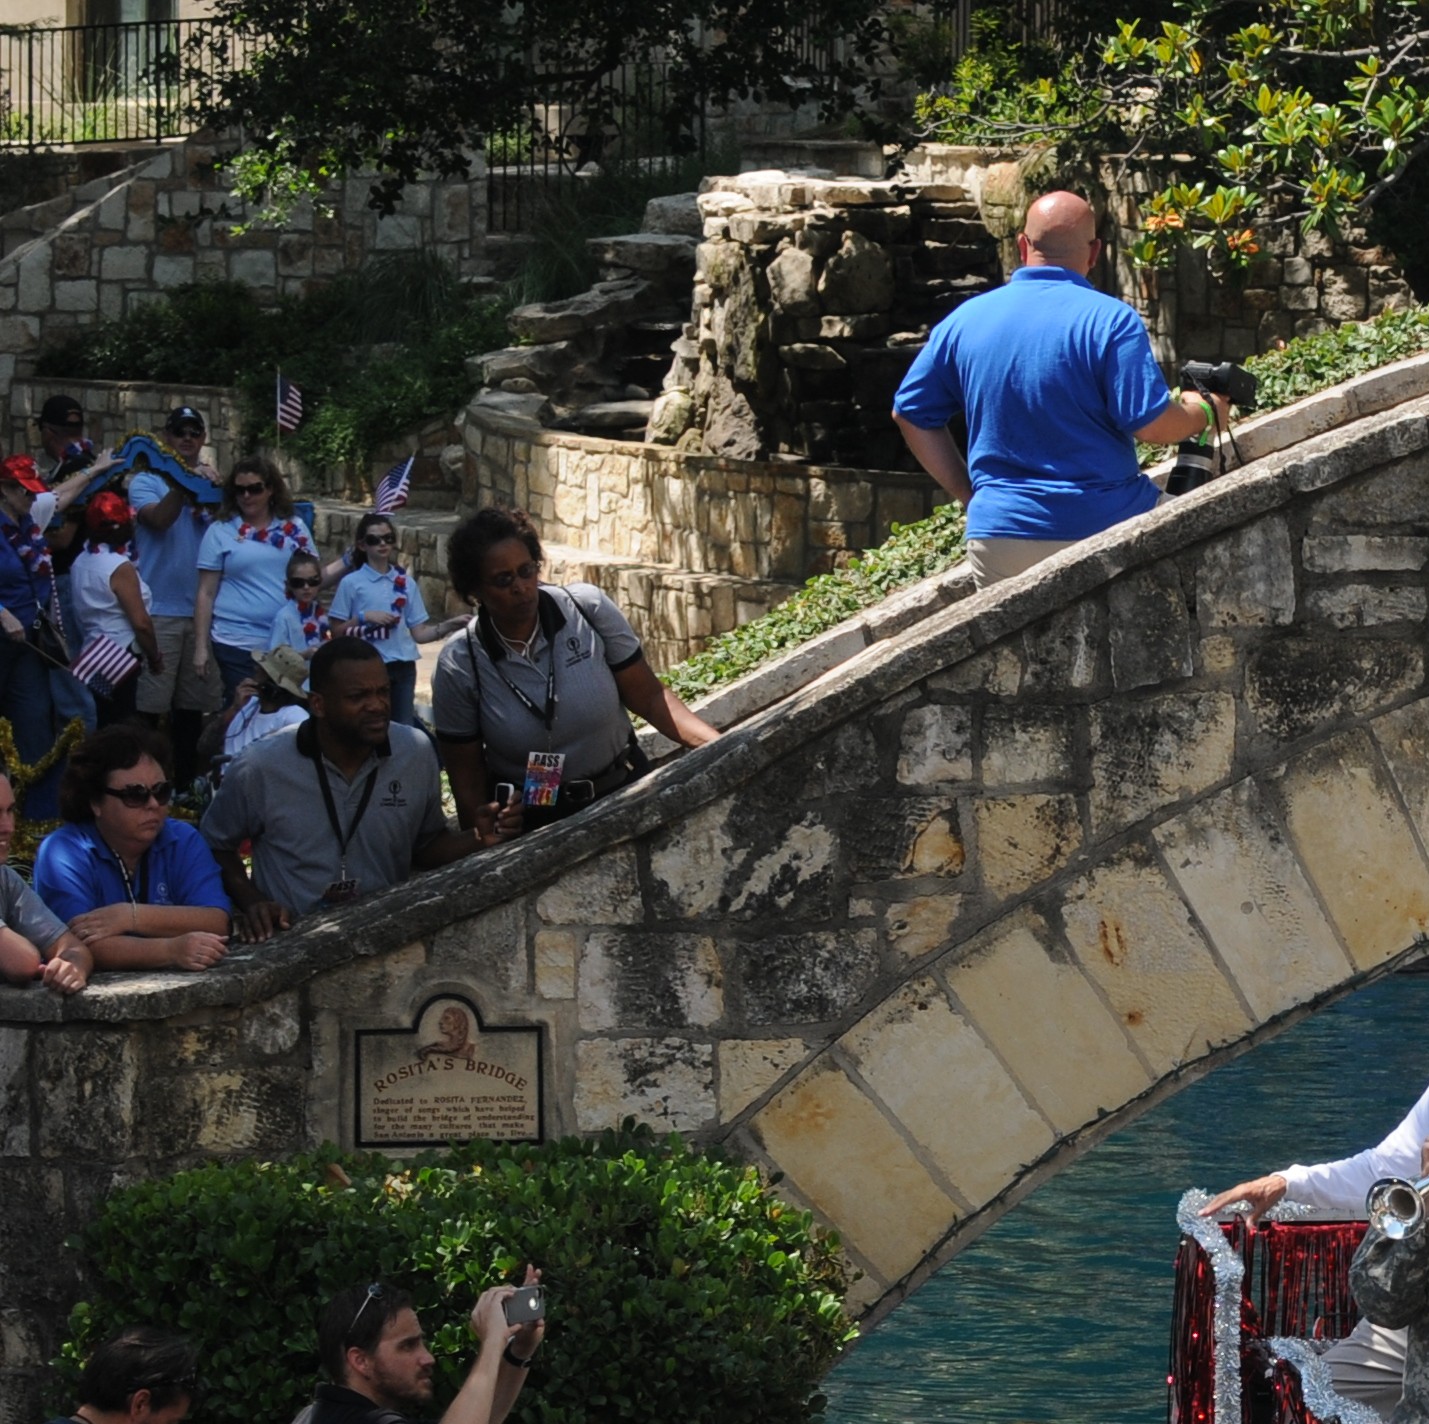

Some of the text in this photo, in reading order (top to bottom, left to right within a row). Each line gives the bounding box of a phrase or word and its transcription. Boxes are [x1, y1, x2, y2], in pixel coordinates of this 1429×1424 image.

[533, 754, 561, 768] PASS
[373, 1058, 528, 1093] ROSITA'S BRIDGE
[373, 1097, 414, 1105] Dedicated
[434, 1096, 465, 1104] ROSITA
[499, 1105, 525, 1113] helped
[432, 1114, 457, 1123] bridge
[477, 1113, 535, 1121] understanding
[439, 1122, 472, 1130] cultures
[479, 1121, 496, 1129] that
[501, 1121, 525, 1129] make
